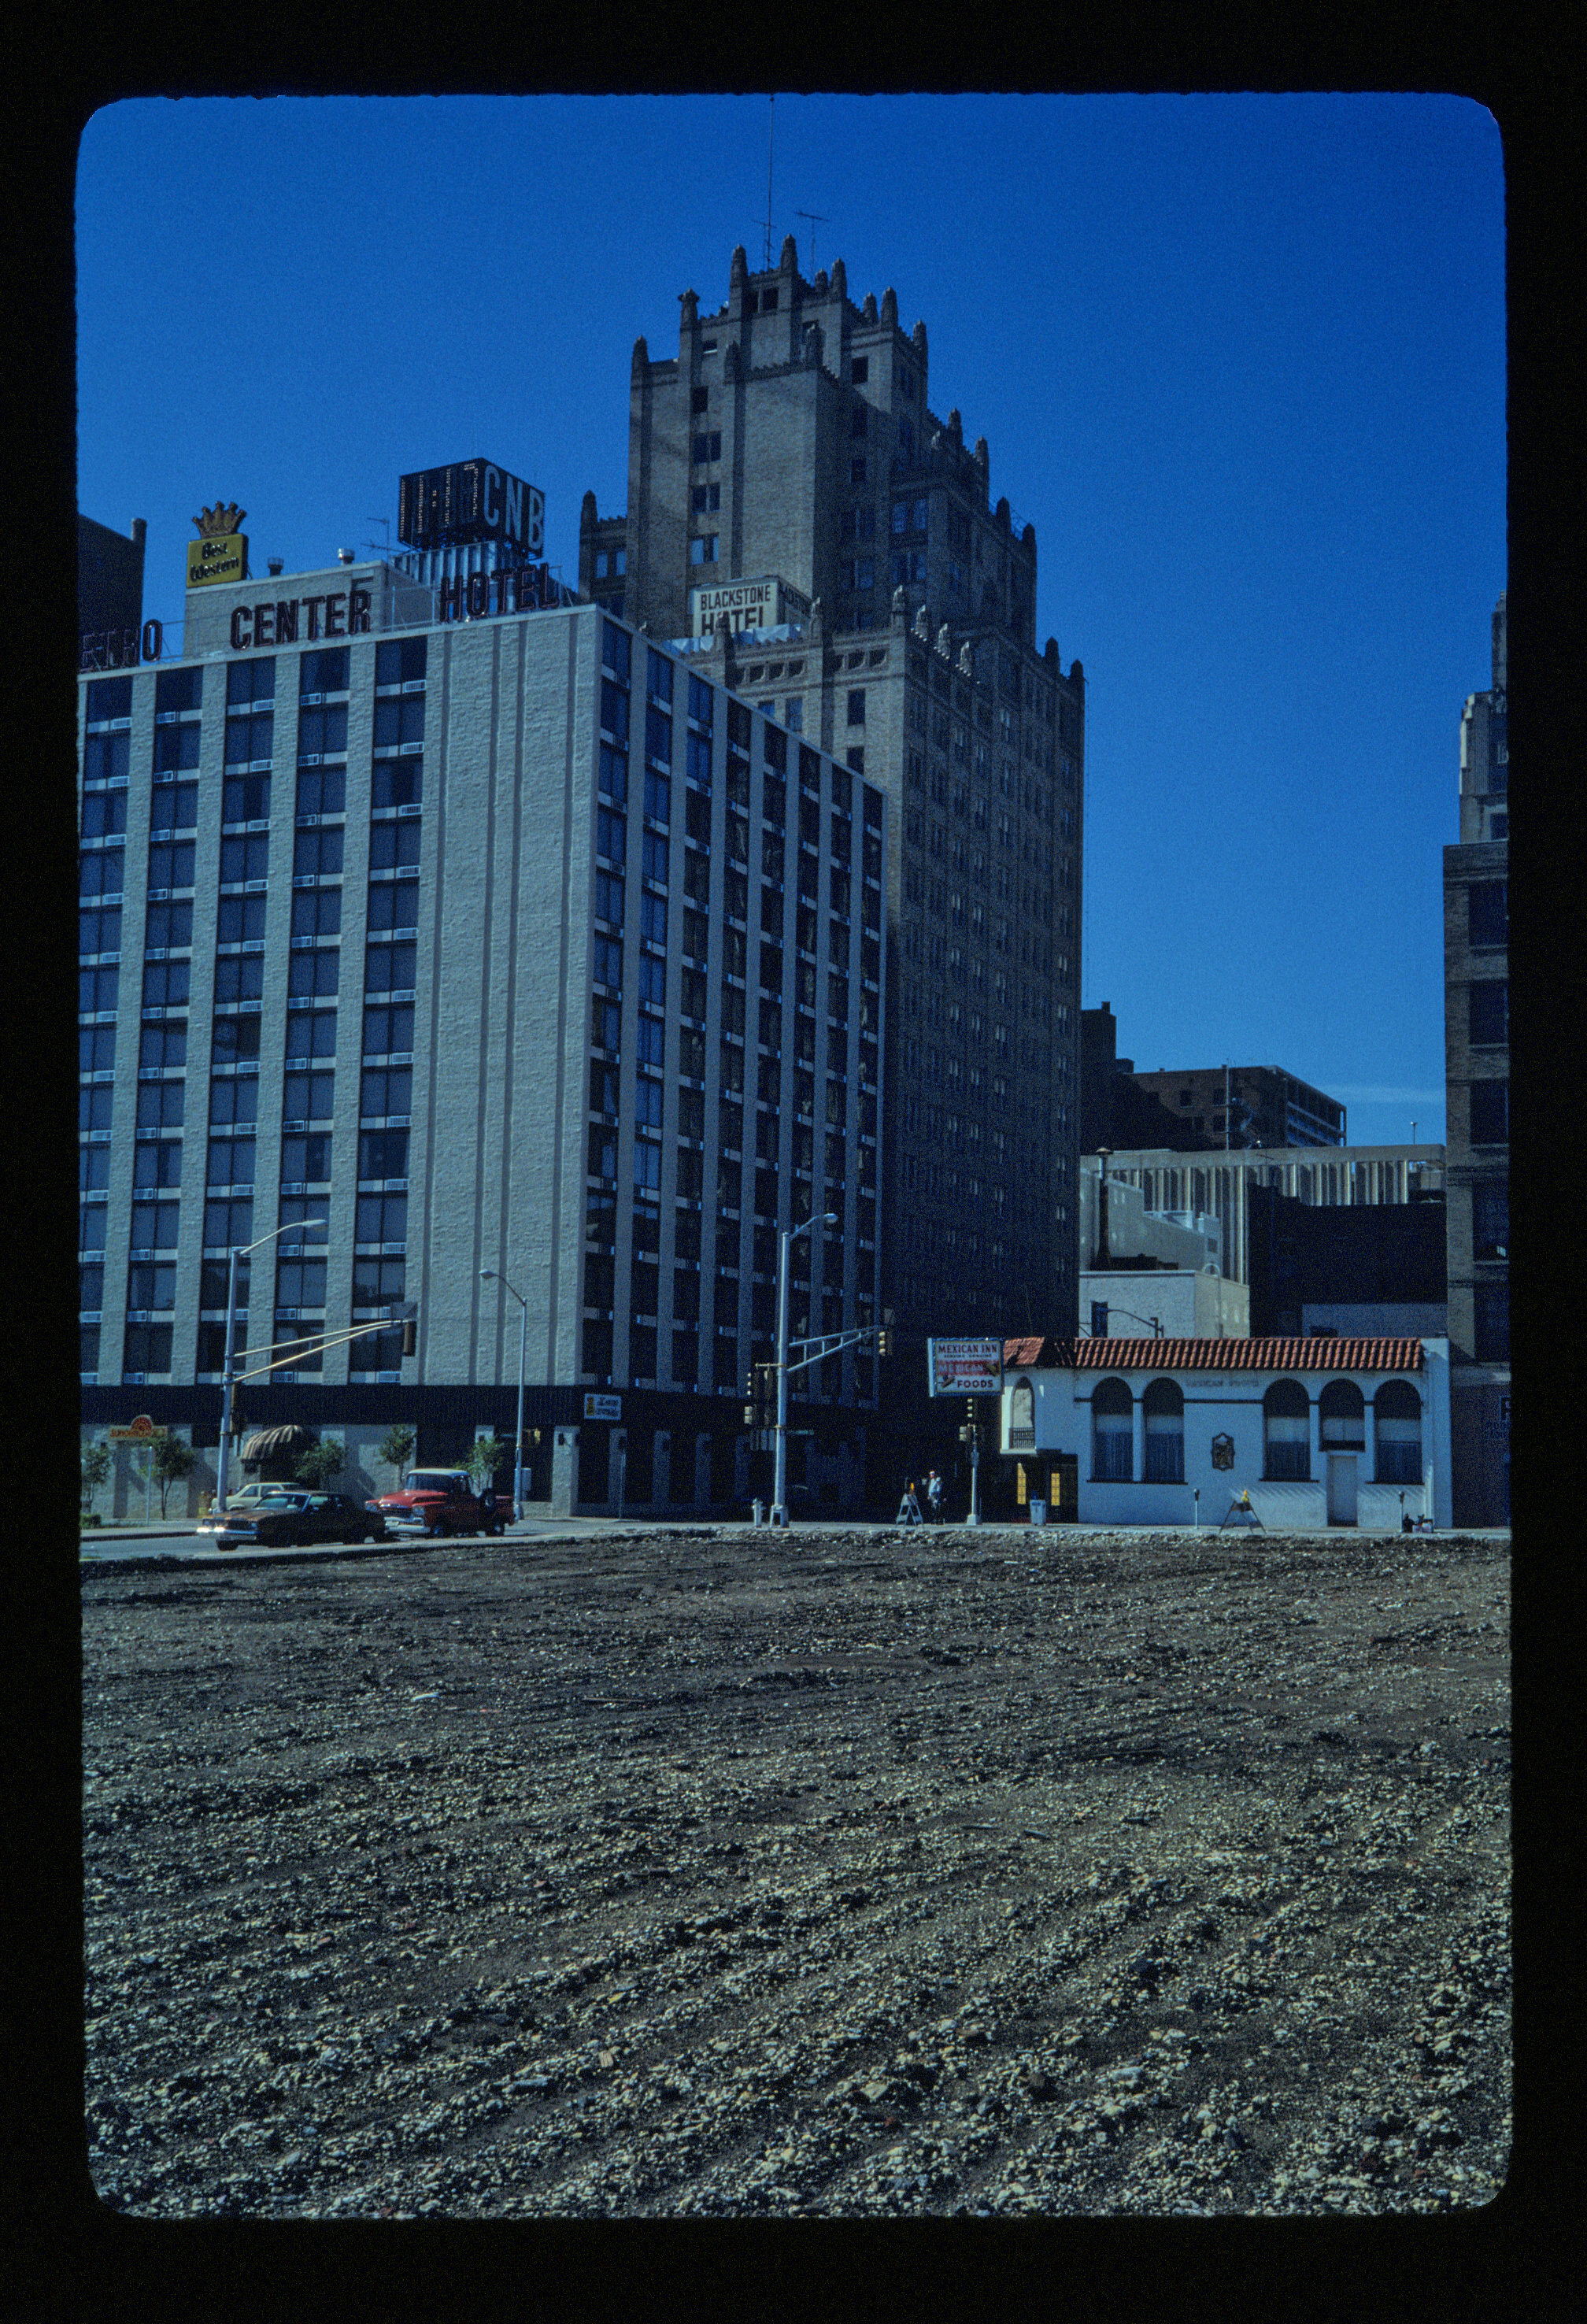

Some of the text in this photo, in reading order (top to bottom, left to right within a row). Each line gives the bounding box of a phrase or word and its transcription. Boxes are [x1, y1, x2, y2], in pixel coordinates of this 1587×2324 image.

[483, 464, 544, 550] CNB
[202, 541, 228, 560] Best
[190, 557, 239, 582] Western
[230, 589, 372, 651] CENTER
[439, 563, 560, 624] HOTEL
[700, 584, 771, 611] BLACKSTONE
[939, 1345, 978, 1353] MEXICAN
[938, 1363, 983, 1373] MEXICAN
[957, 1379, 993, 1388] FOODS
